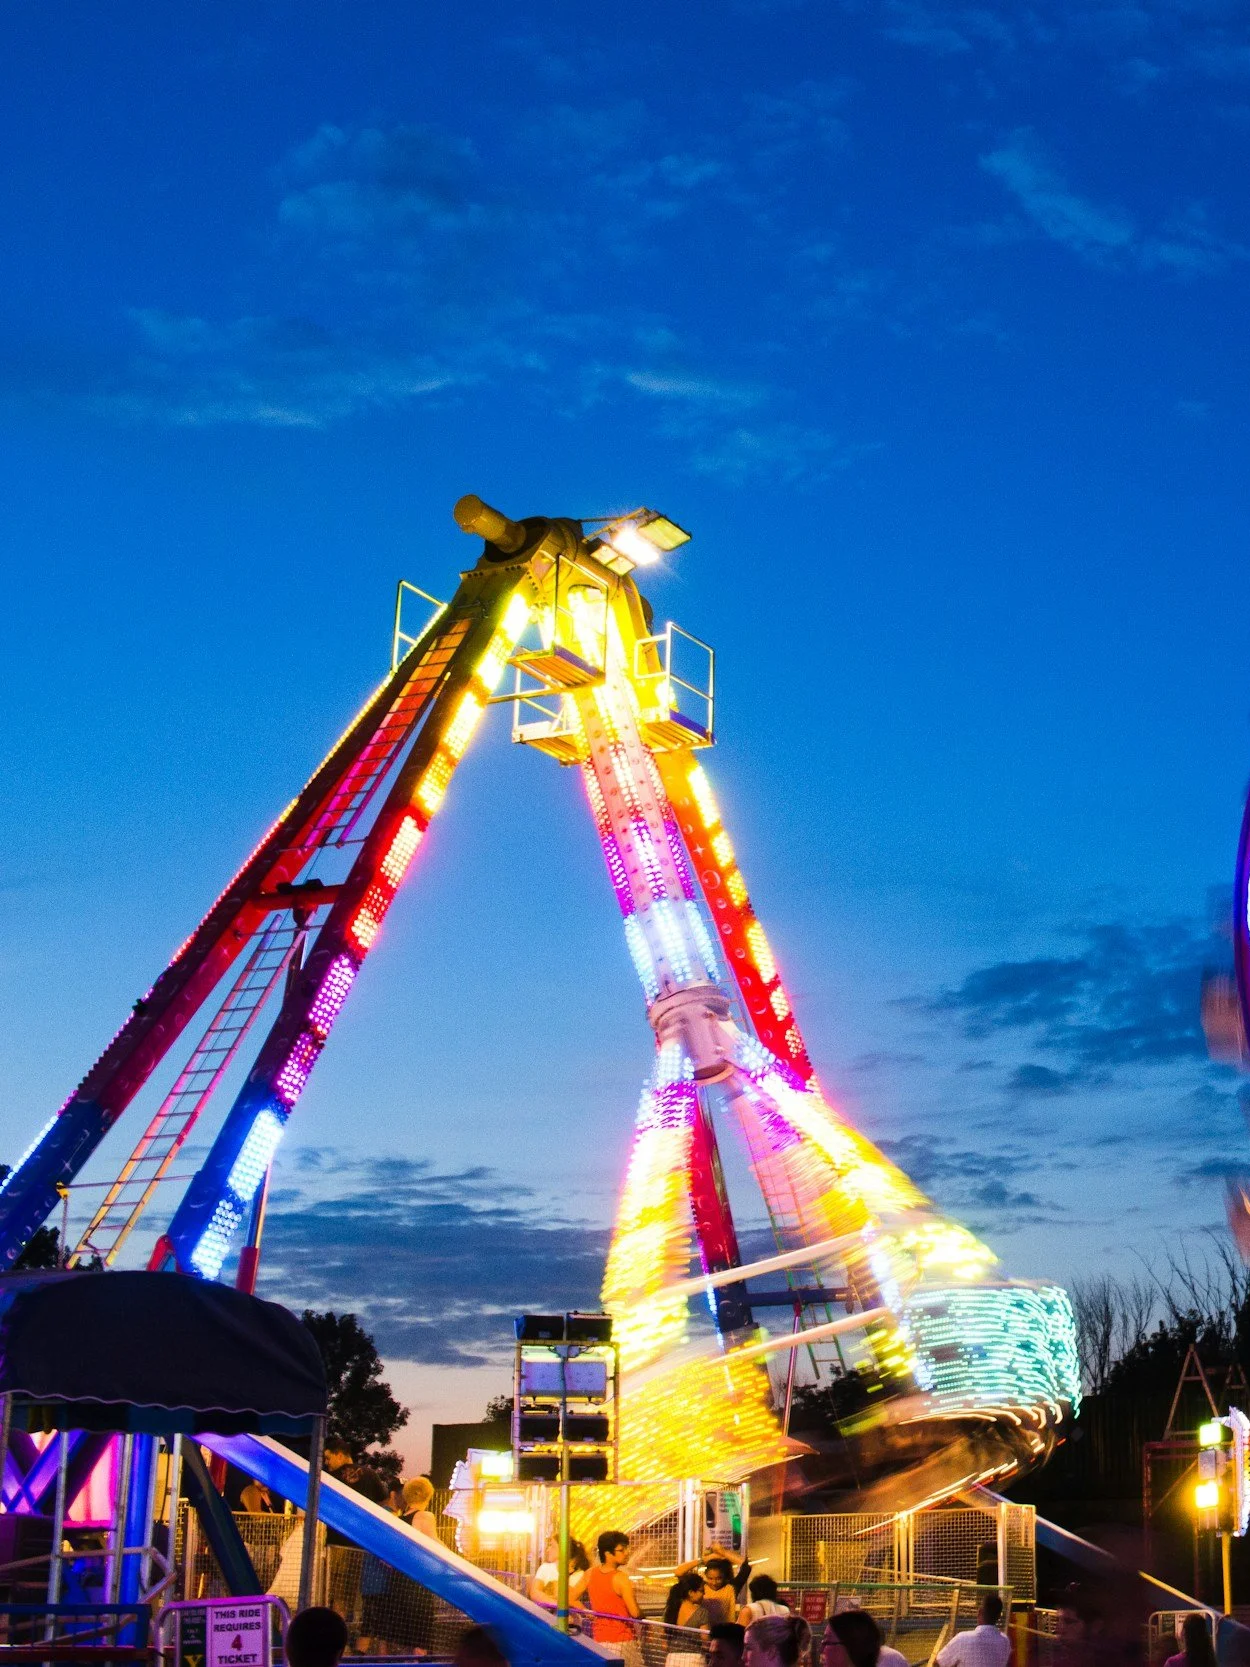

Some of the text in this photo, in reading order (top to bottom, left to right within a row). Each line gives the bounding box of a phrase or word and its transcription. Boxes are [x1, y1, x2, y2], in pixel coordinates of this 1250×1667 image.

[214, 1610, 236, 1619] THIS
[238, 1608, 261, 1618] RIDE
[213, 1621, 261, 1632] REQUIRES
[231, 1633, 243, 1651] 4
[217, 1653, 258, 1665] TICKET
